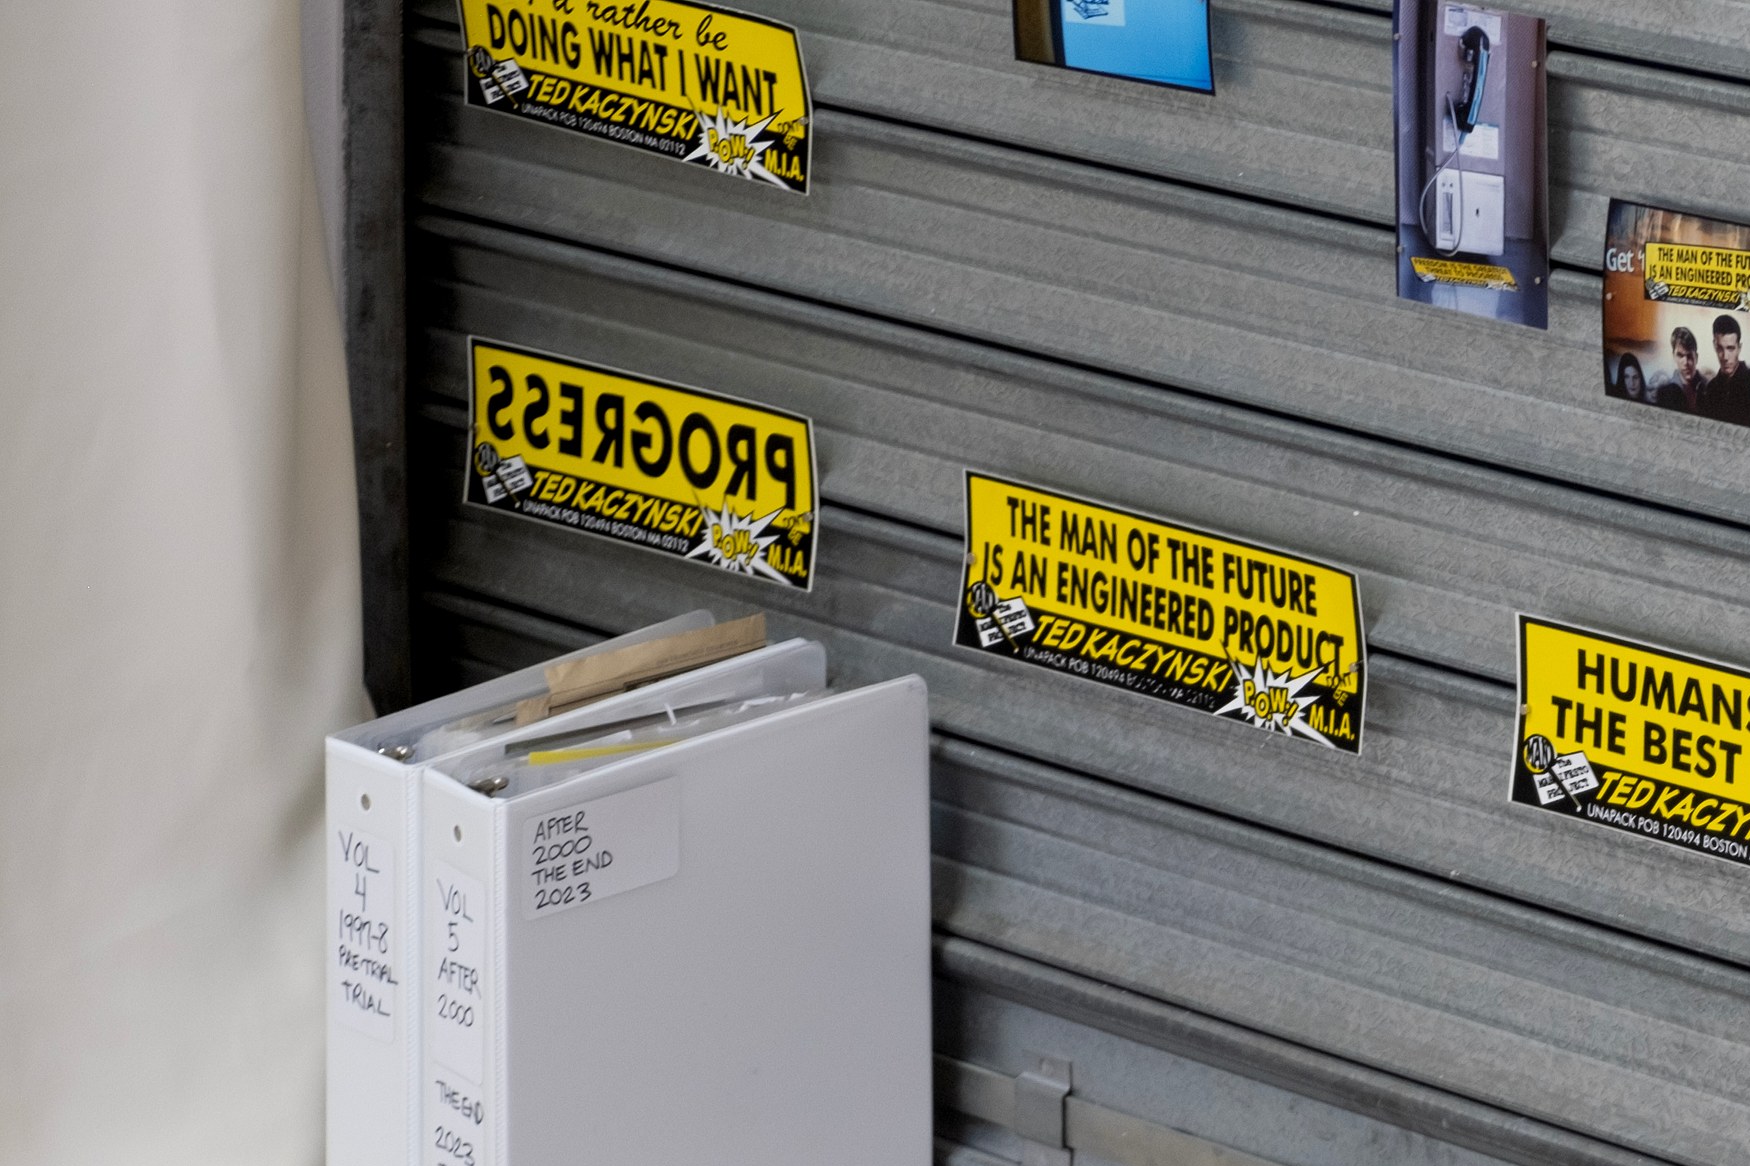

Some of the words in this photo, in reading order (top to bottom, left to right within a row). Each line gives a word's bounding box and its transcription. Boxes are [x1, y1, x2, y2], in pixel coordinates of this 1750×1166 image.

[587, 0, 683, 40] rather
[696, 14, 729, 51] be
[487, 2, 581, 71] DOING
[587, 26, 668, 91] WHAT
[678, 48, 686, 97] I
[694, 52, 777, 117] WANT
[526, 73, 569, 108] TED
[569, 85, 700, 141] KACZYNSKI
[1606, 248, 1634, 273] Get
[1650, 264, 1657, 279] IS
[1659, 266, 1672, 280] AN
[1675, 267, 1732, 287] ENGINEERED
[1658, 247, 1674, 263] THE
[1676, 249, 1698, 265] MAN
[1700, 251, 1713, 266] OF
[1715, 253, 1733, 269] THE
[1668, 285, 1685, 297] TED
[1685, 286, 1741, 303] KACZYNSKI
[530, 471, 573, 505] TED
[573, 481, 703, 539] KACZYNSKI
[1007, 496, 1050, 546] THE
[1060, 510, 1117, 565] MAN
[1126, 528, 1159, 574] OF
[1167, 538, 1214, 590] THE
[1223, 552, 1317, 617] FUTURE
[981, 541, 1003, 586] IS
[1010, 551, 1047, 598] AN
[1057, 562, 1215, 642] ENGINEERED
[1223, 606, 1344, 676] PRODUCT
[1032, 615, 1084, 651] TED
[1086, 628, 1233, 694] KACZYNSKI
[1551, 695, 1626, 756] THE
[1643, 721, 1743, 779] BEST
[1594, 770, 1654, 808] TED
[533, 811, 589, 844] AFTER
[1587, 803, 1637, 829] UNAPACK
[1637, 815, 1660, 835] POB
[1662, 822, 1700, 845] 120494
[1703, 834, 1747, 860] BOSTON
[338, 830, 380, 874] VOL
[531, 864, 567, 886] THE
[572, 850, 614, 876] END
[533, 835, 593, 866] 2000
[354, 873, 367, 914] 4
[436, 878, 474, 923] VOL
[535, 882, 593, 911] 2023
[339, 908, 389, 955] 1997-8
[447, 921, 460, 953] 5
[341, 980, 391, 1018] TRIAL
[437, 957, 481, 1000] AFTER
[438, 993, 474, 1027] 2000
